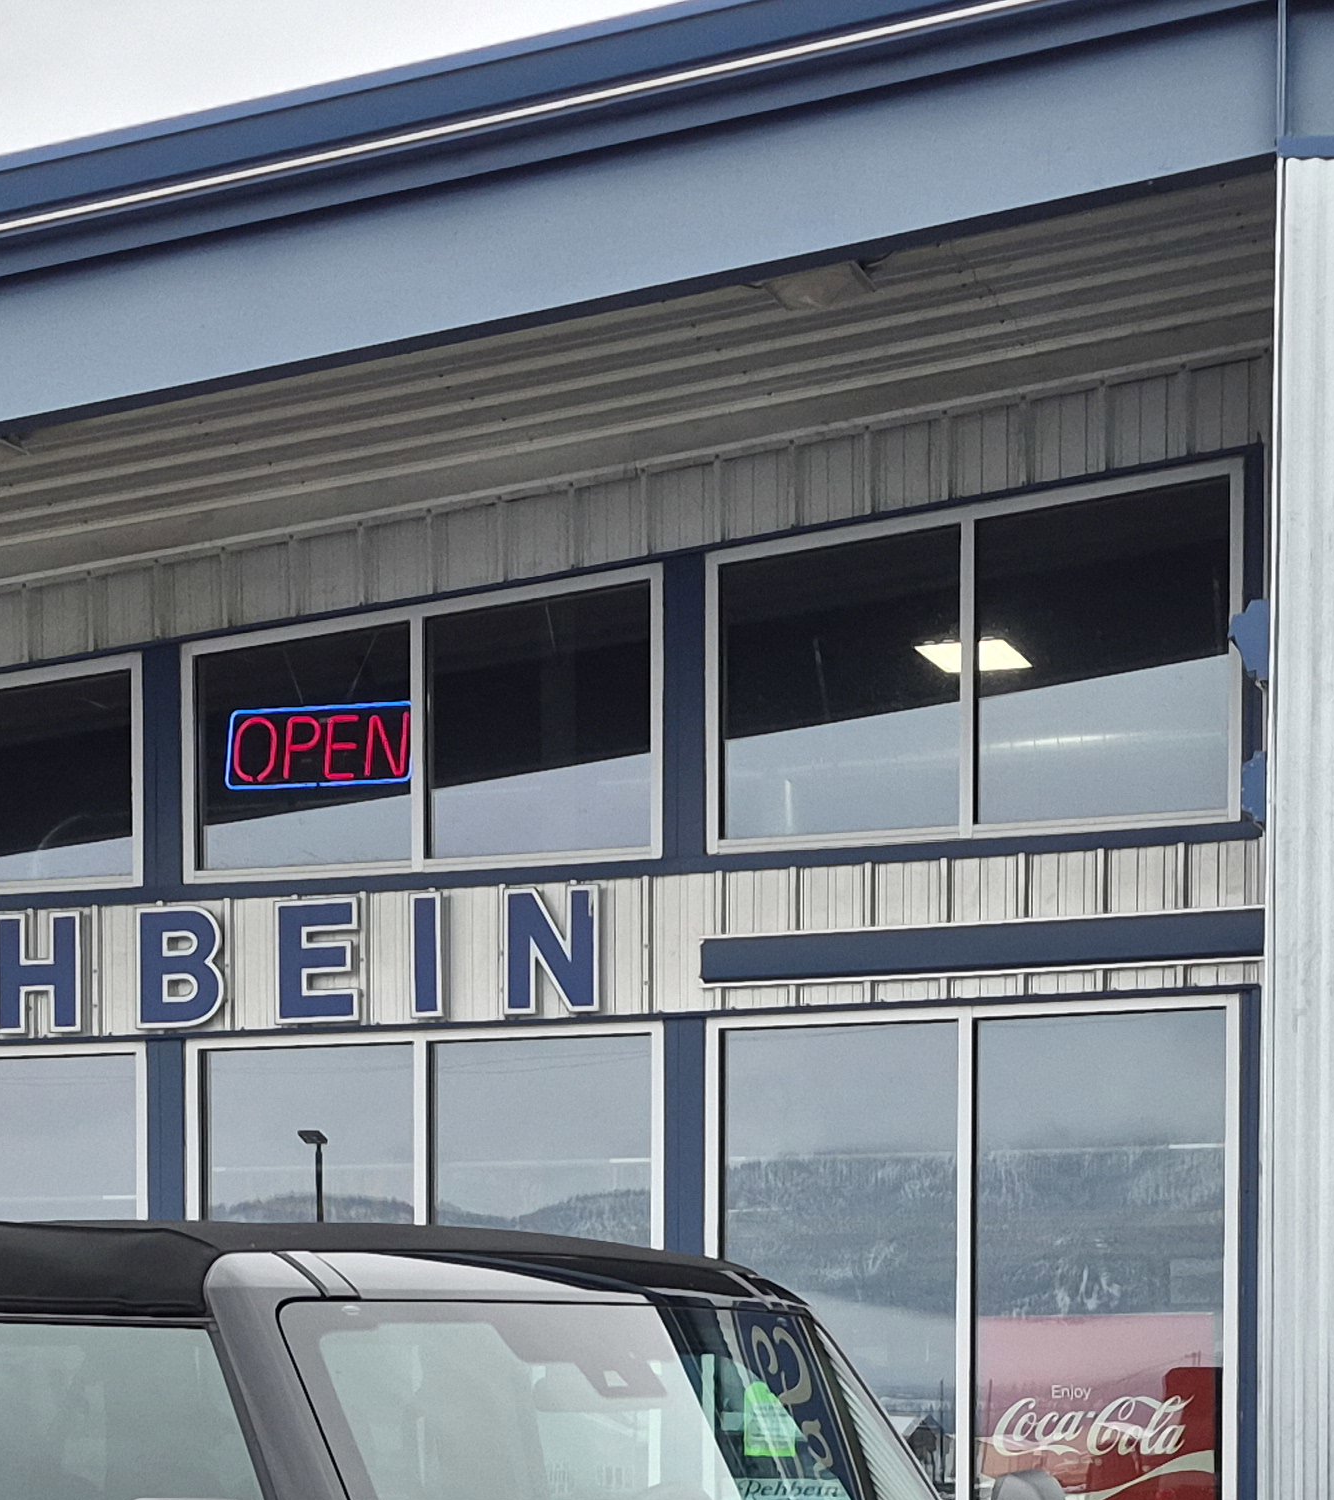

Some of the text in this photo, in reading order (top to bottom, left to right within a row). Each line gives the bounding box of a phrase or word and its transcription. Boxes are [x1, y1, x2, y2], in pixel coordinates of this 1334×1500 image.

[233, 711, 410, 783] OPEN
[1051, 1385, 1092, 1400] Enjoy
[992, 1394, 1194, 1457] Coca-Cola
